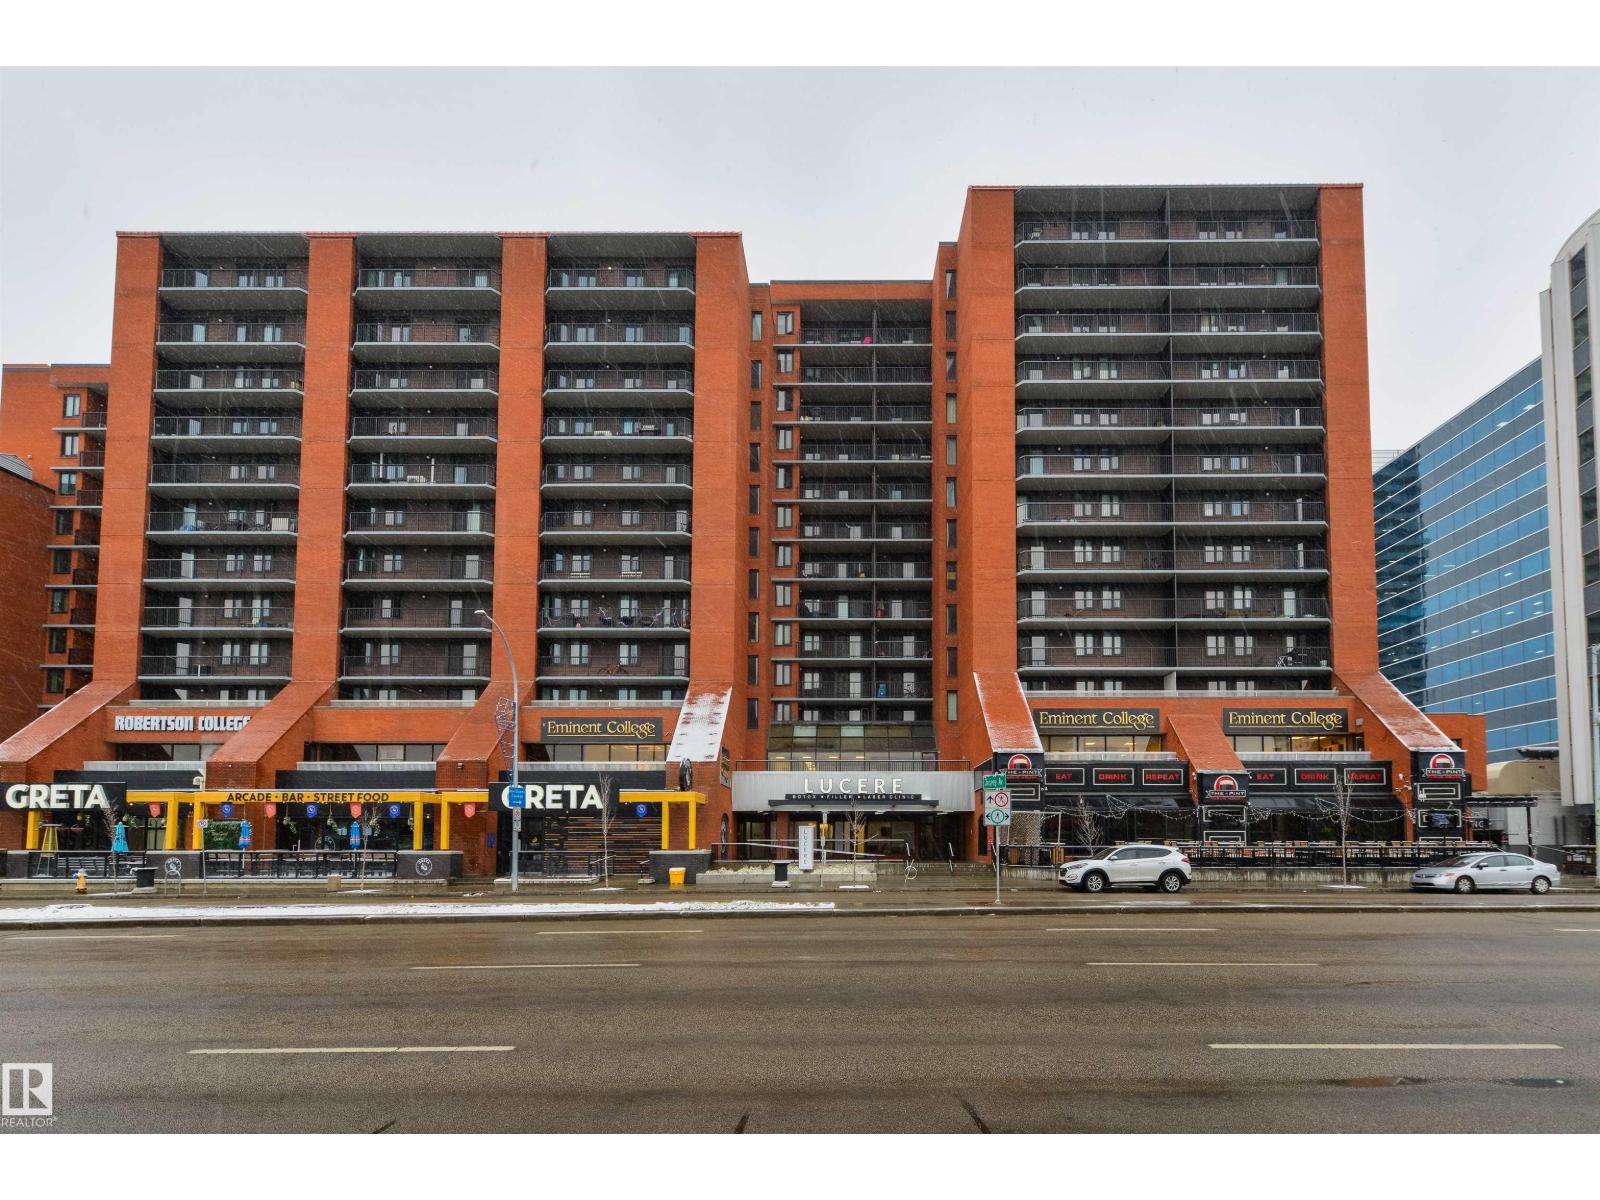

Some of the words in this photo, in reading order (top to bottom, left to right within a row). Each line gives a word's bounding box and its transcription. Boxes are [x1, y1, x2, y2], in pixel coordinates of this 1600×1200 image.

[115, 715, 194, 731] ROBERTSON
[547, 721, 602, 733] Eminent
[607, 721, 656, 739] College
[1039, 712, 1097, 725] Eminent
[1102, 711, 1154, 731] College
[1229, 712, 1286, 725] Eminent
[1291, 711, 1342, 731] College
[804, 778, 903, 794] LUCERE
[5, 783, 111, 809] GRETA
[227, 793, 272, 802] ARCADE
[282, 793, 304, 802] BAR
[313, 793, 354, 802] STREET
[357, 793, 389, 802] FOOD
